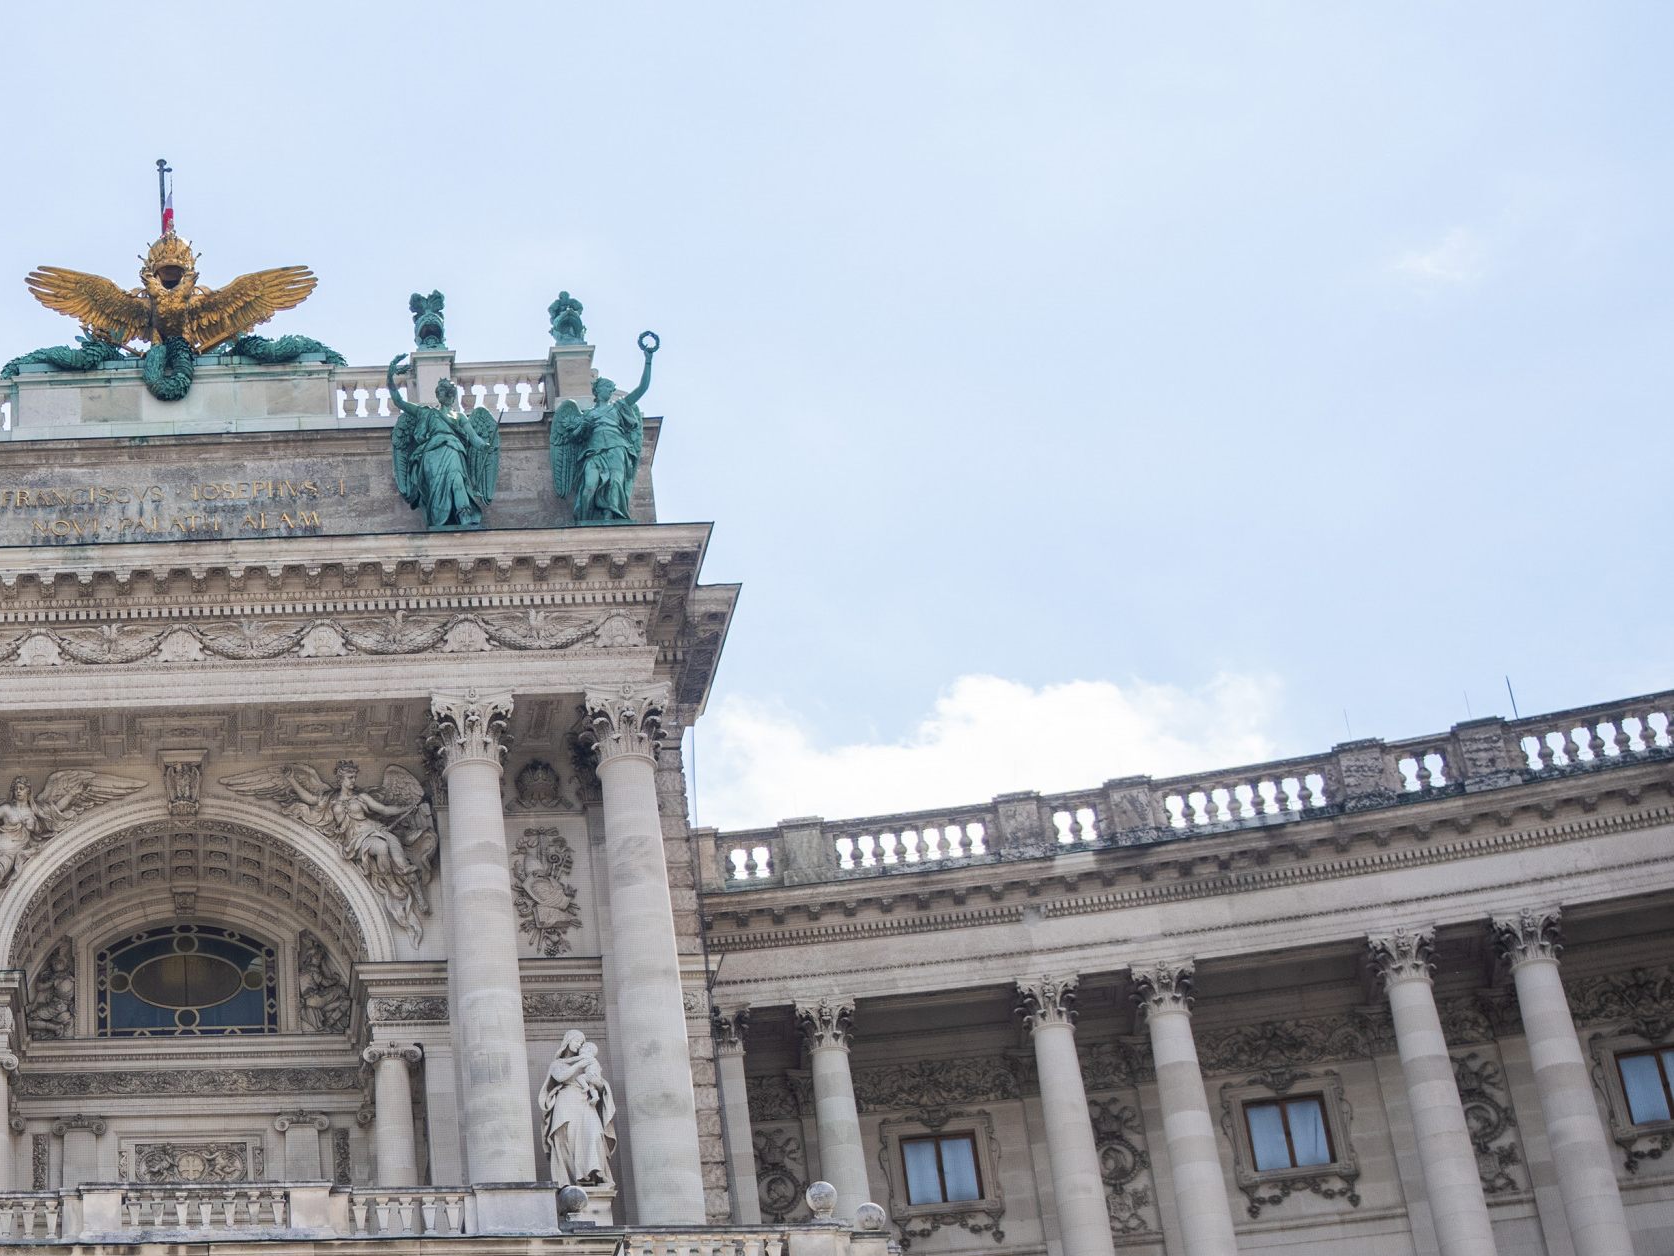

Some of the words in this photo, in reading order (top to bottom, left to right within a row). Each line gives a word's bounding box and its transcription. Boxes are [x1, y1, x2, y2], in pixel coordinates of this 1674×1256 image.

[1, 485, 164, 506] FRANCISCVS
[192, 479, 318, 500] IOSEPHVS
[32, 516, 98, 536] NOVI
[243, 509, 321, 530] ALAM
